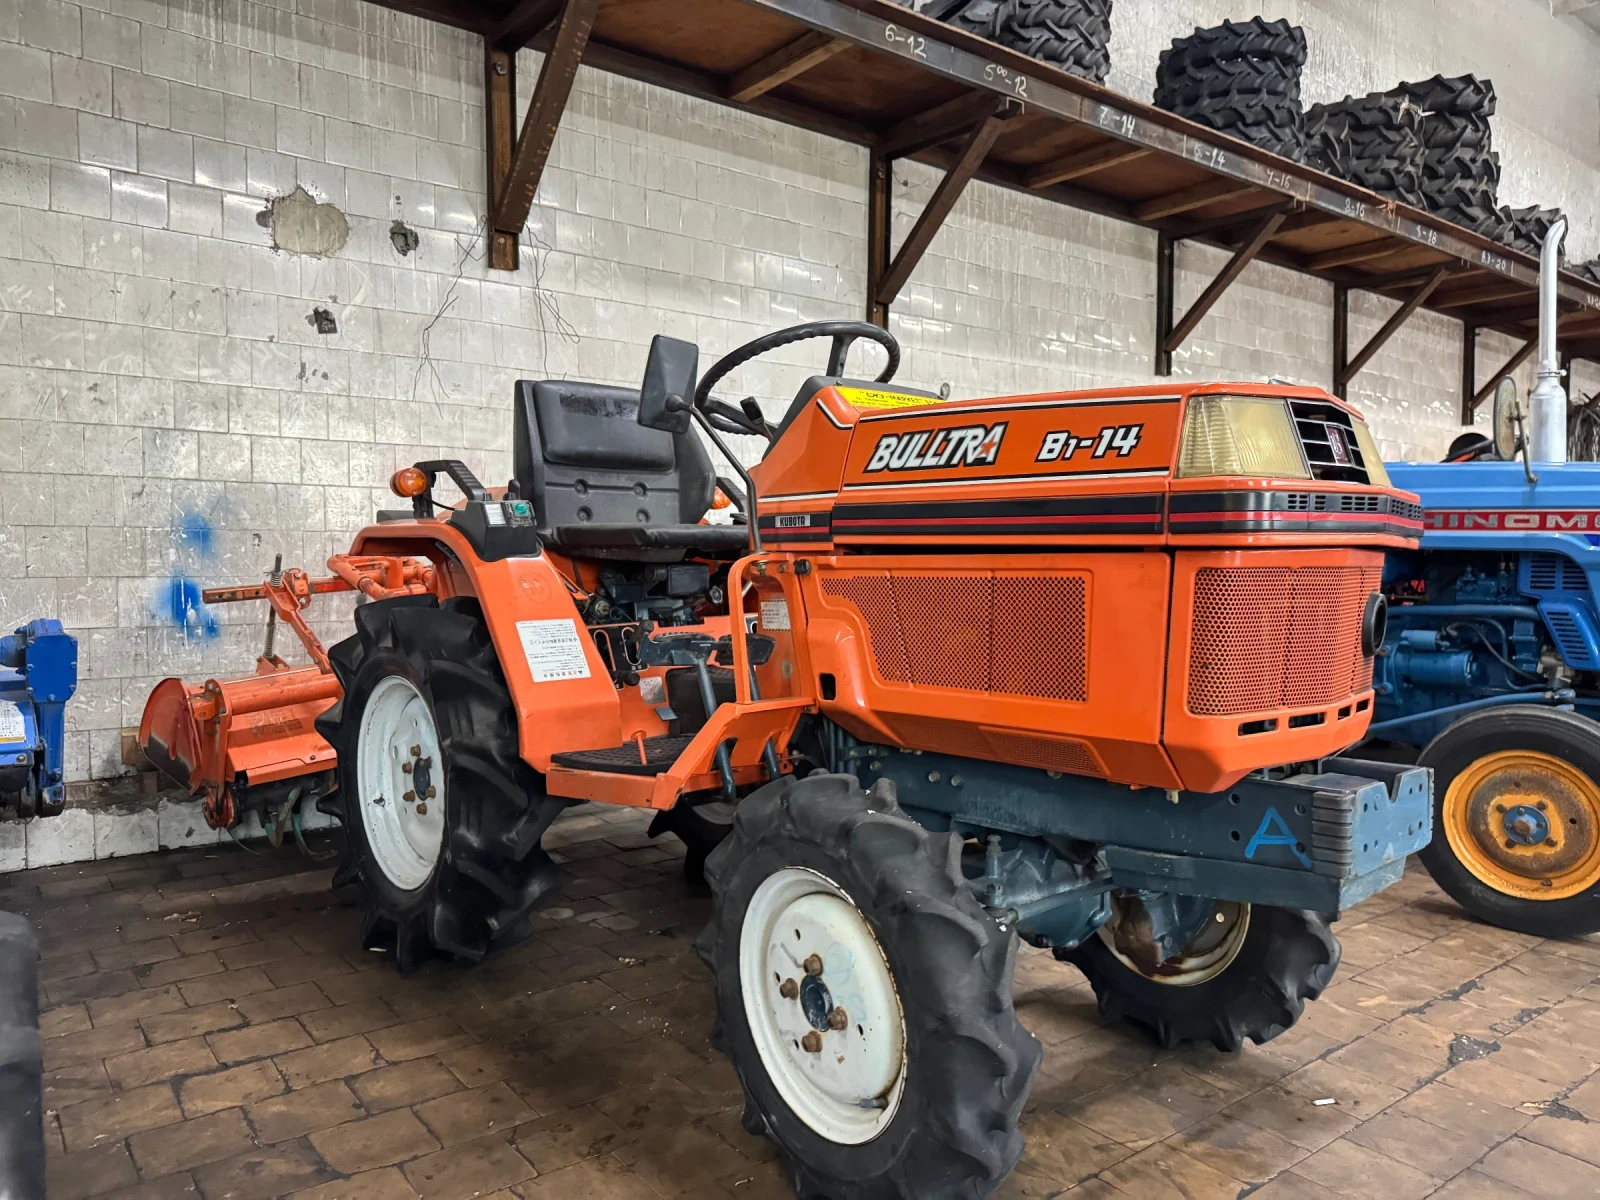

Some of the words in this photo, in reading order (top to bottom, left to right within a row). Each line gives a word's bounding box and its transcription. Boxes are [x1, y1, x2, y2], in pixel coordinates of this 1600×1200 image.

[885, 24, 927, 58] 6-12
[864, 422, 1008, 472] BULLTRA
[1036, 425, 1143, 462] B1-14
[779, 515, 806, 527] KUBOTA
[1424, 513, 1600, 528] HINOM
[1244, 806, 1312, 868] A
